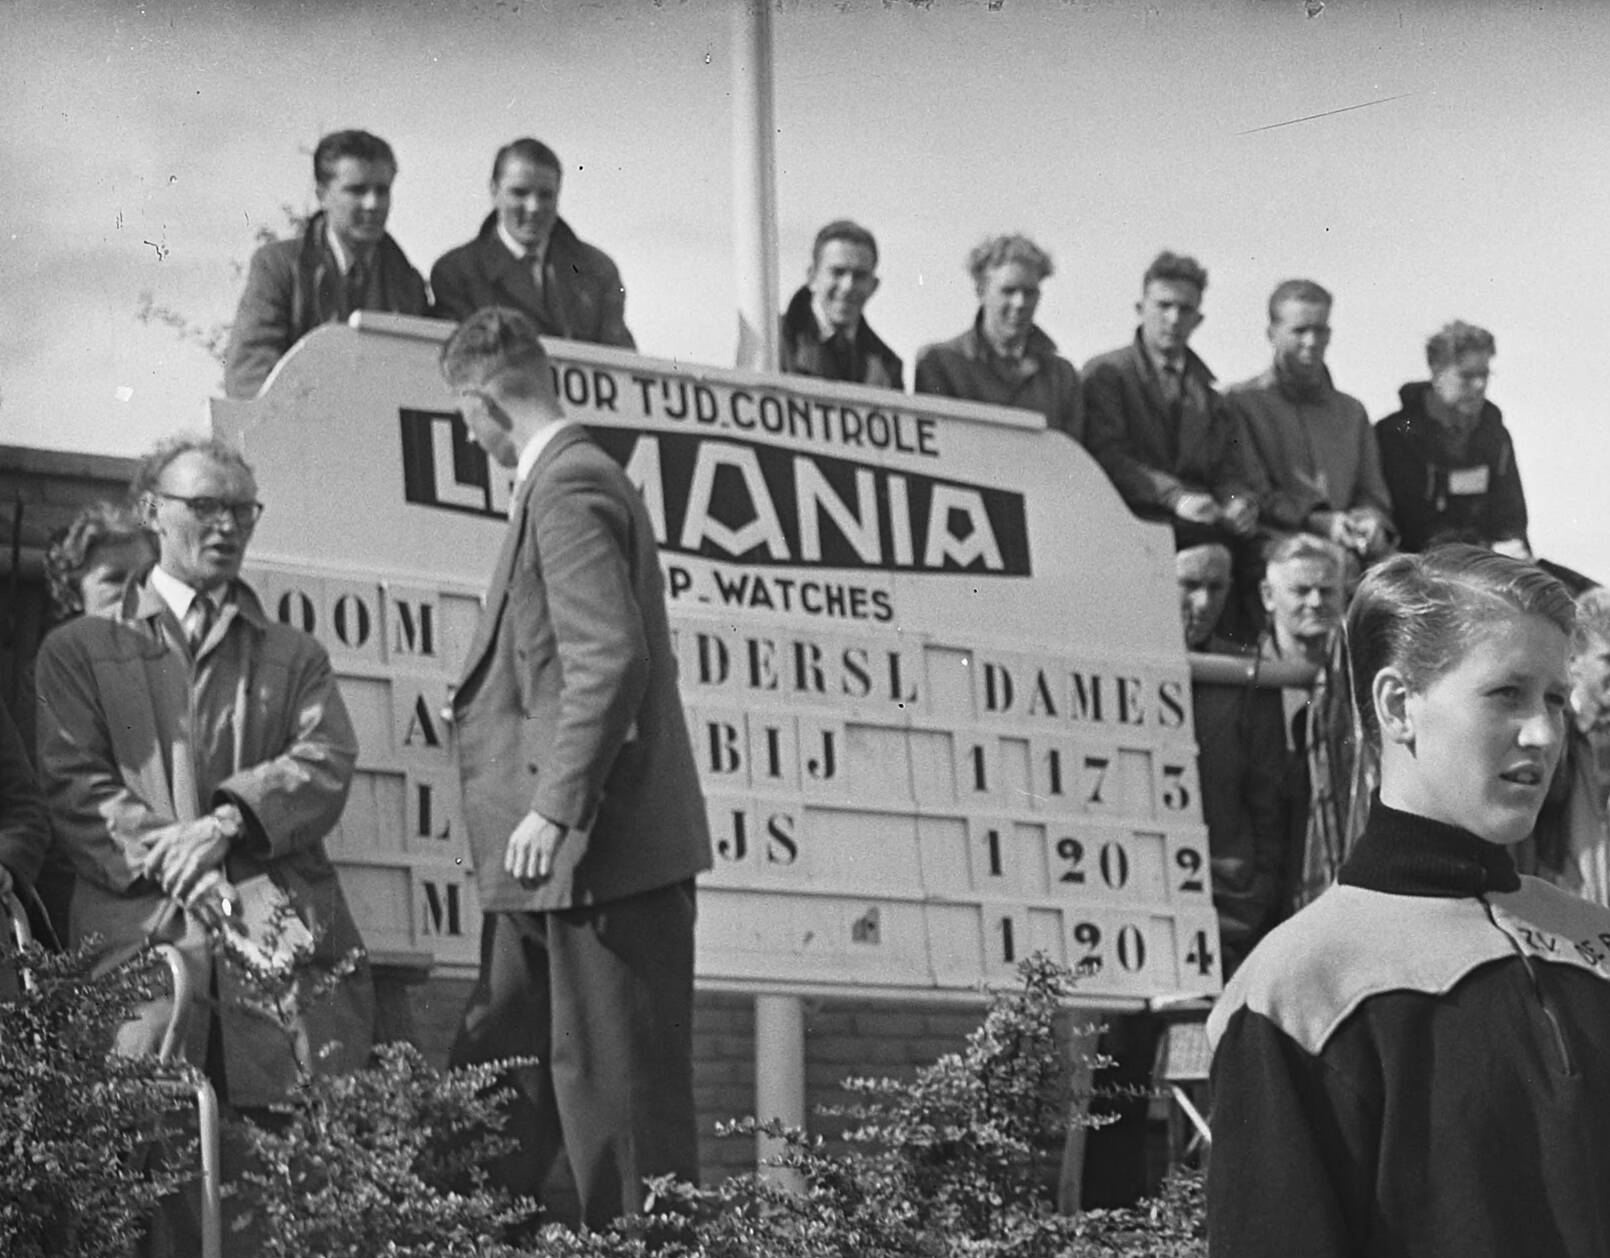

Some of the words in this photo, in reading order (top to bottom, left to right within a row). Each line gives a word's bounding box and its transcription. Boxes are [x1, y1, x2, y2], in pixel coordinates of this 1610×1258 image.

[982, 661, 1186, 729] DAMES
[707, 719, 837, 781] BIJ
[966, 745, 989, 795] 1
[1046, 749, 1109, 803] 17
[415, 784, 450, 840] L
[716, 809, 799, 867] JS
[982, 830, 1003, 878] 1
[1056, 837, 1131, 891] 20
[1174, 847, 1203, 892] 2
[421, 880, 462, 936] M
[998, 916, 1016, 964] 1
[1073, 921, 1147, 974] 20
[1185, 929, 1214, 977] 4
